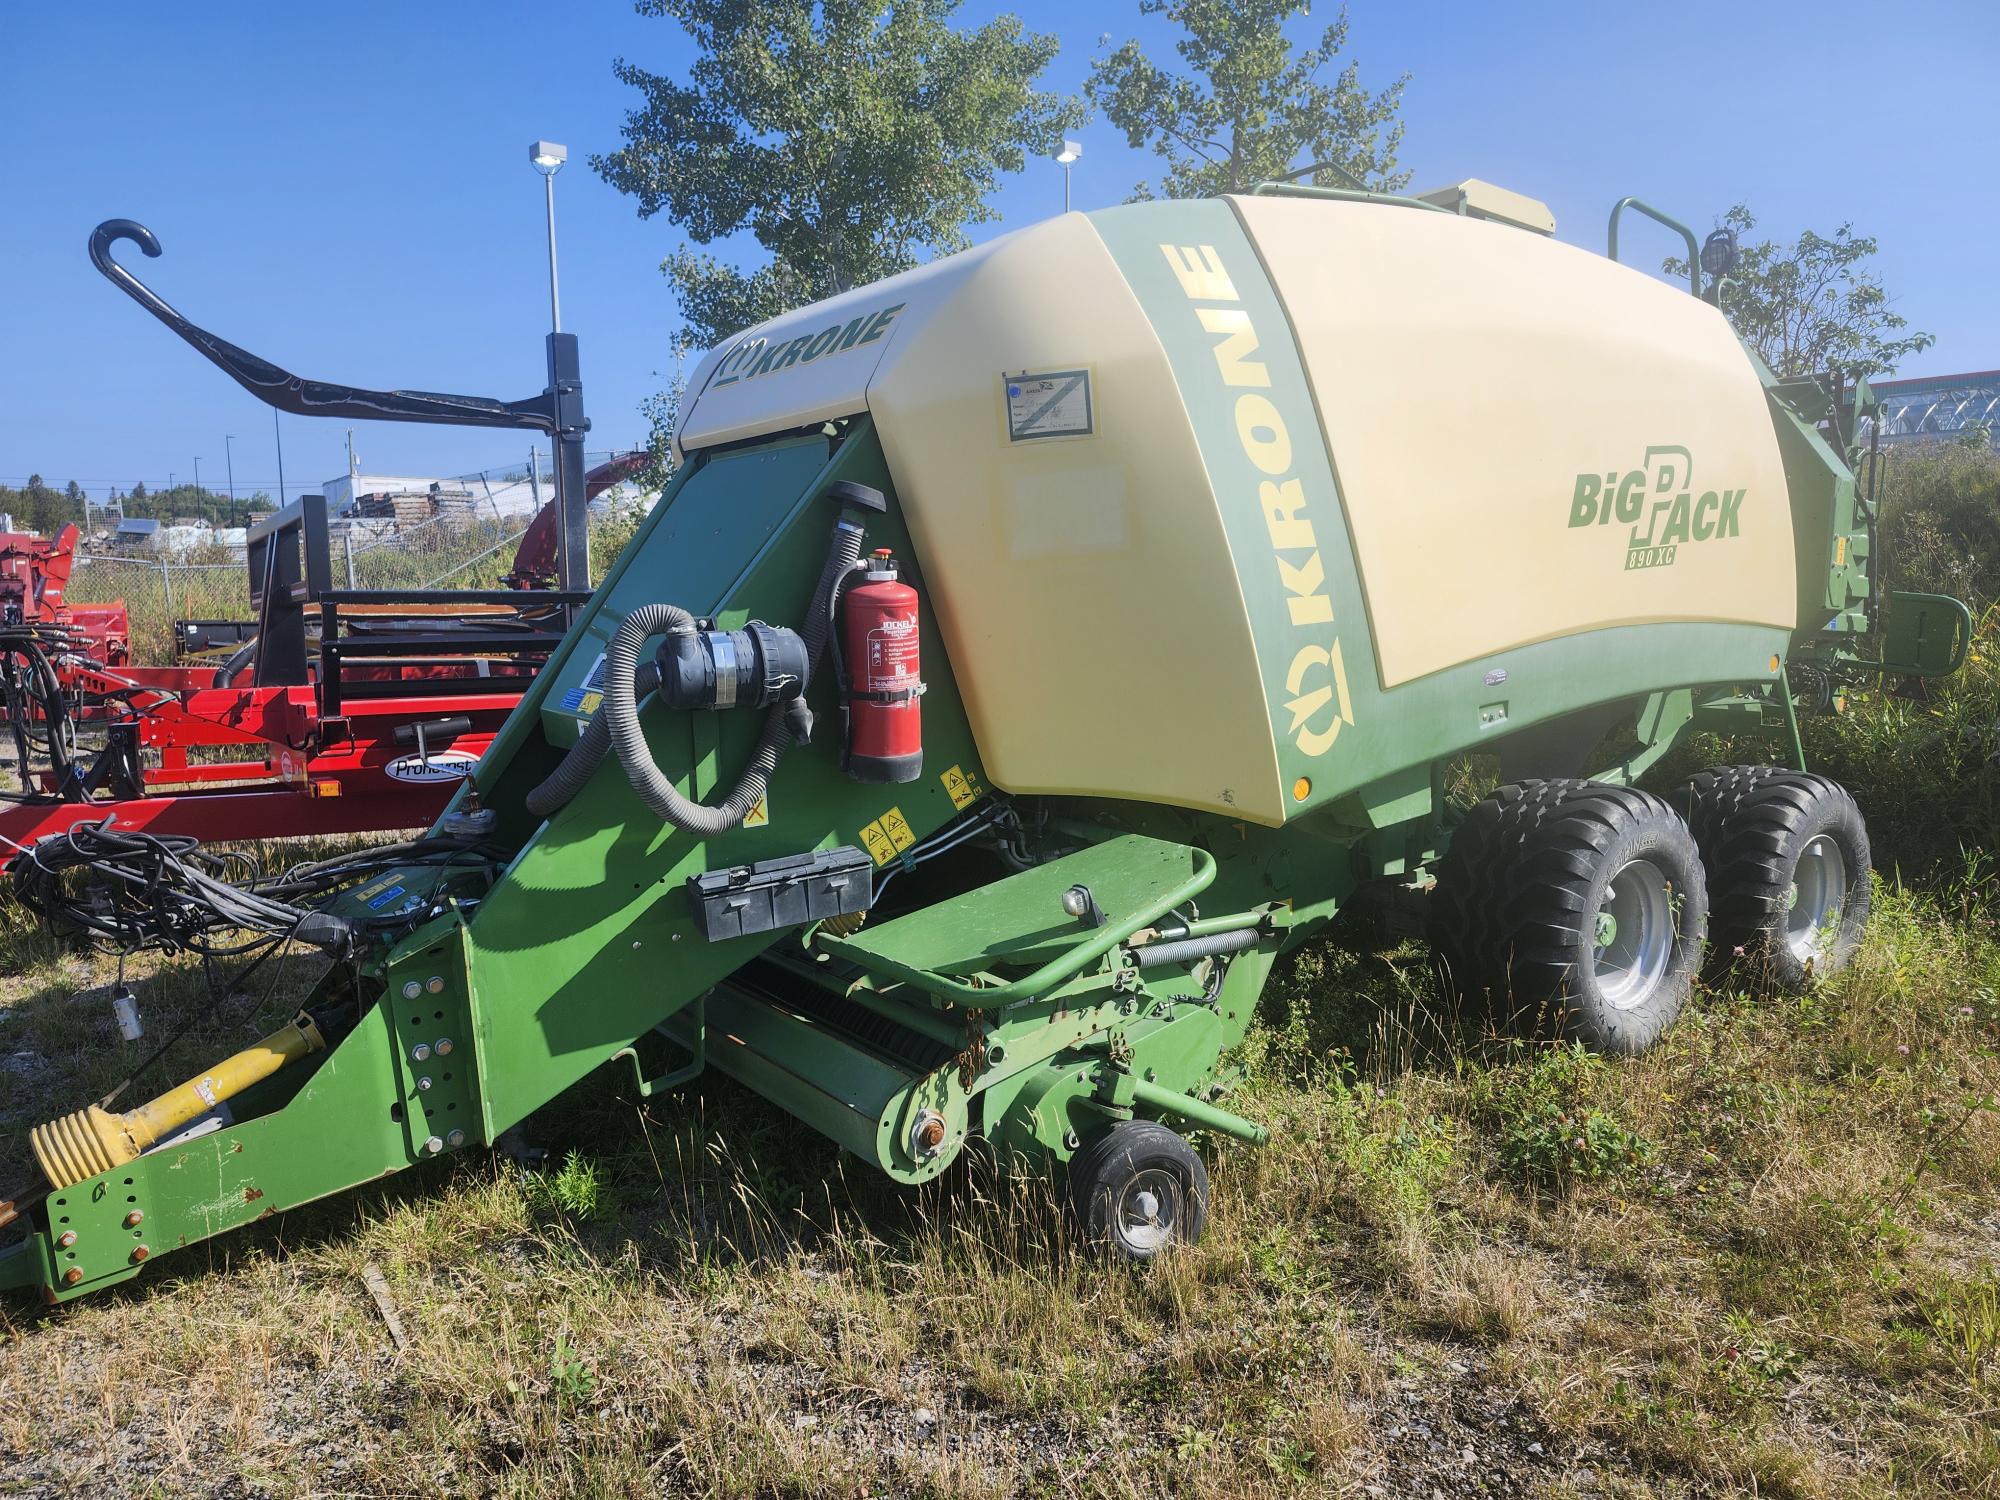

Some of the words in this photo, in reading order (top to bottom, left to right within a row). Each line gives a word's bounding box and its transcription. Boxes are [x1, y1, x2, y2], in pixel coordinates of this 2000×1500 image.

[745, 302, 907, 380] KRONE
[1159, 243, 1335, 627] KRONE
[1629, 549, 1653, 569] 890
[1656, 547, 1675, 566] XC
[395, 760, 472, 776] Pronoost
